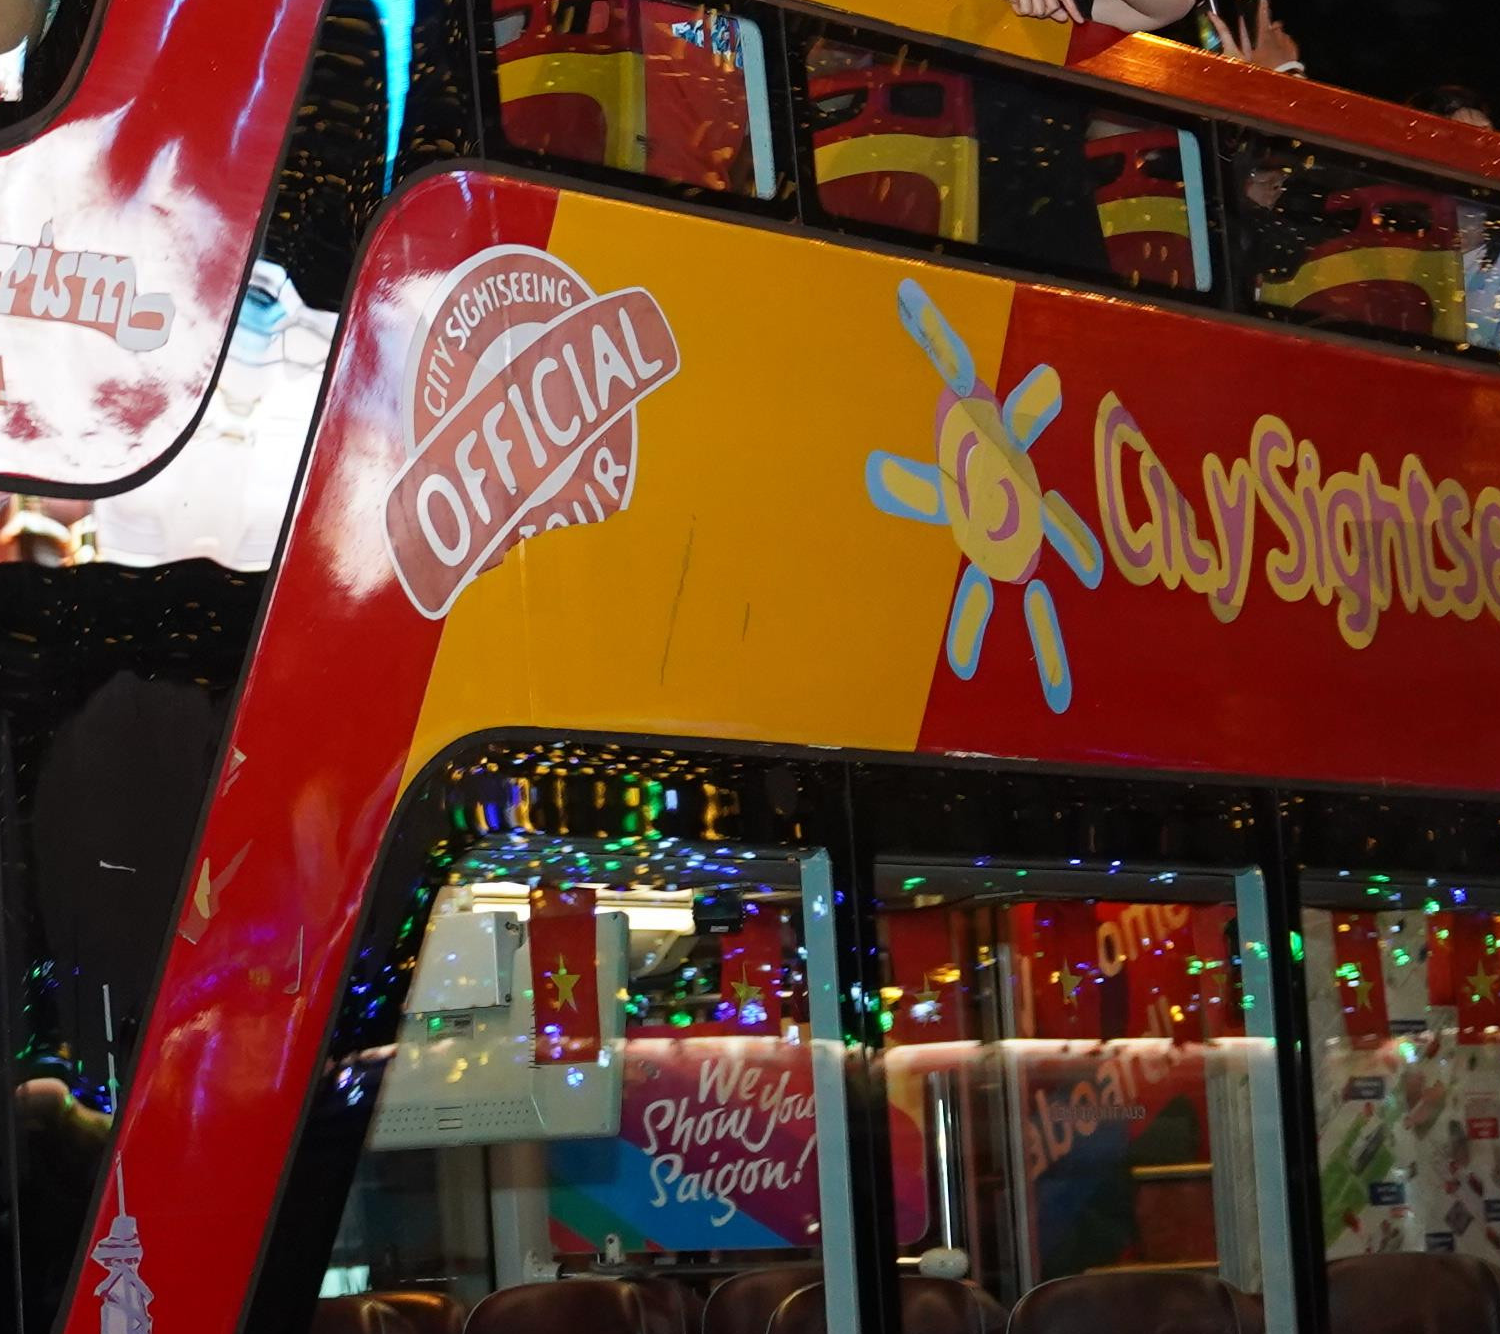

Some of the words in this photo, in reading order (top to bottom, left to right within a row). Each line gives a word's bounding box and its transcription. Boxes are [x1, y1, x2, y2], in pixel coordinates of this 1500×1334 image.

[422, 335, 455, 418] CITY
[445, 271, 573, 352] SIGHTSEEING
[416, 307, 663, 567] OFFICIAL
[641, 1097, 752, 1156] Show
[698, 1057, 763, 1105] We
[650, 1133, 818, 1227] Saigon!
